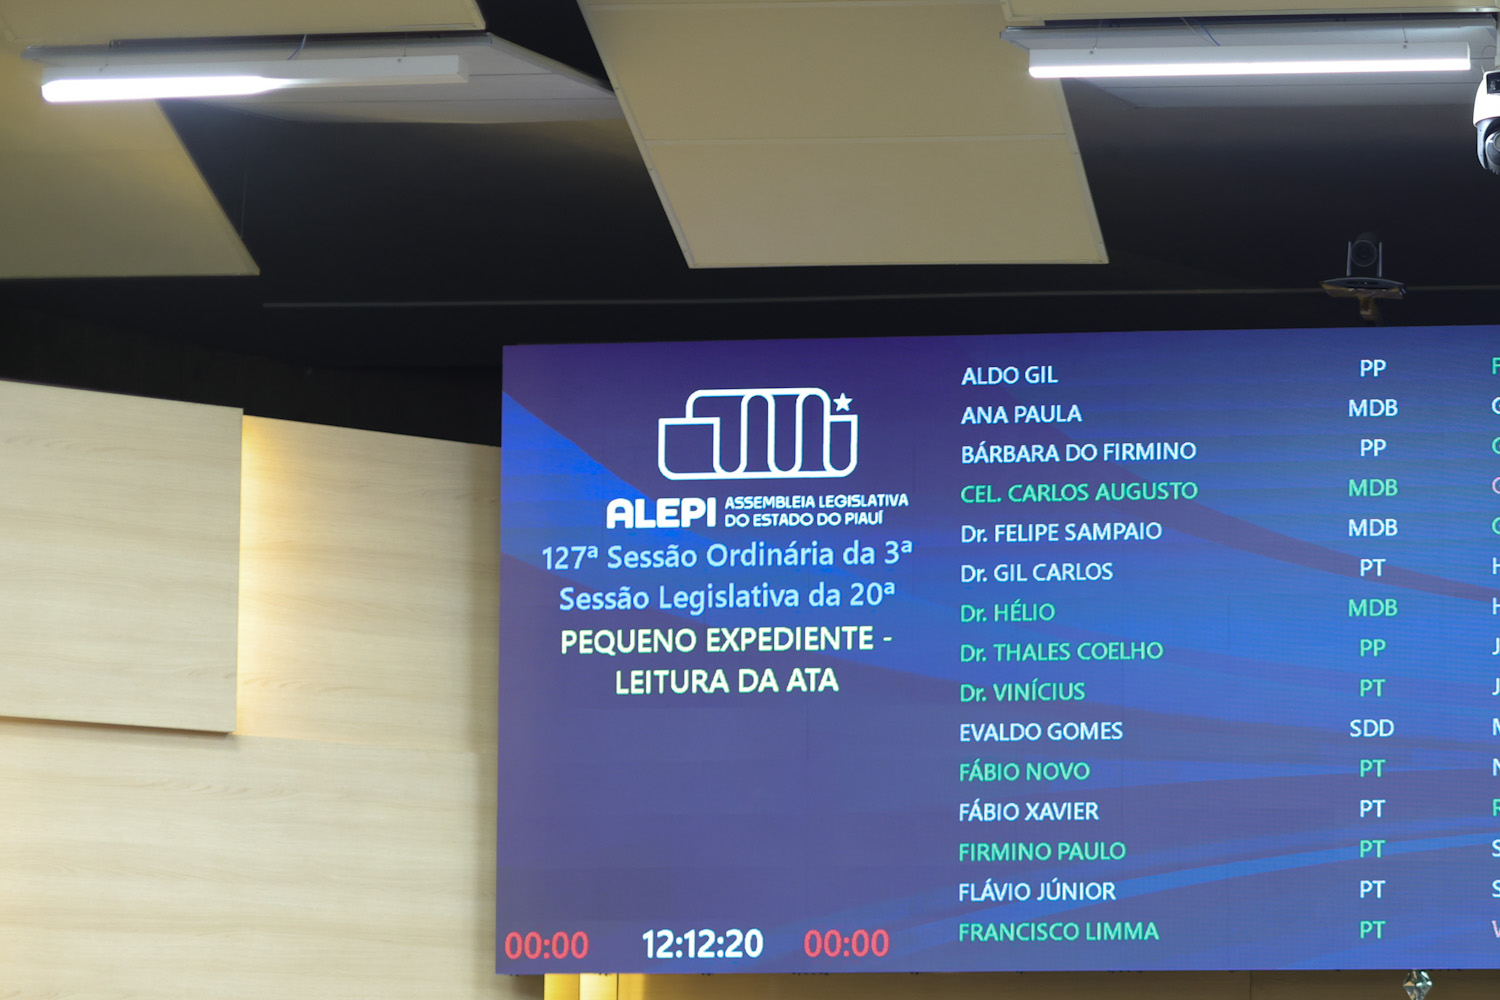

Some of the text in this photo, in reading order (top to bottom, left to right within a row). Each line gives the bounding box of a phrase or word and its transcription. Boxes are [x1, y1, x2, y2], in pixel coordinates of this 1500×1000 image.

[961, 365, 1059, 386] ALDO GIL
[1360, 359, 1387, 377] PP
[960, 404, 1083, 425] ANA PAULA
[1348, 398, 1398, 417] MDB
[961, 440, 1197, 464] BÁRBARA DO FIRMINO
[1360, 438, 1387, 457] PP
[960, 481, 1198, 503] CEL. CARLOS AUGUSTO
[1348, 478, 1398, 497] MDB
[606, 496, 717, 529] ALEPI
[724, 493, 909, 511] ASSEMBLEIA LEGISLATIVA
[724, 509, 884, 528] DO ESTADO DO PIAUÍ
[1348, 518, 1398, 537] MDB
[961, 521, 1162, 543] Dr. FELIPE SAMPAIO
[607, 544, 698, 569] Sessão
[706, 540, 834, 567] Ordinária
[842, 539, 875, 565] da
[961, 562, 1114, 583] Dr. GIL CARLOS
[1360, 558, 1387, 577] PT
[559, 585, 650, 611] Sessão
[659, 581, 799, 616] Legislativa
[808, 581, 841, 607] da
[1348, 598, 1398, 617] MDB
[960, 598, 1056, 623] Dr. HÉLIO
[561, 628, 697, 656] PEQUENO
[706, 625, 874, 652] EXPEDIENTE
[1360, 638, 1386, 657] PP
[960, 641, 1164, 662] Dr. THALES COELHO
[615, 667, 840, 695] LEITURA DA ATA
[960, 677, 1085, 702] Dr. VINÍCIUS
[1360, 678, 1386, 697] PT
[960, 721, 1123, 742] EVALDO GOMES
[1349, 718, 1395, 737] SDD
[959, 758, 1091, 782] FÁBIO NOVO
[1360, 759, 1386, 778] PT
[959, 797, 1099, 822] FÁBIO XAVIER
[1360, 799, 1386, 818] PT
[959, 841, 1126, 862] FIRMINO PAULO
[1360, 839, 1386, 858] PT
[959, 877, 1117, 902] FLÁVIO JÚNIOR
[1360, 879, 1386, 899] PT
[959, 921, 1160, 942] FRANCISCO LIMMA
[1360, 920, 1386, 939] PT
[504, 930, 590, 960] 00:00
[642, 928, 764, 959] 12:12:20
[803, 928, 890, 958] 00:00
